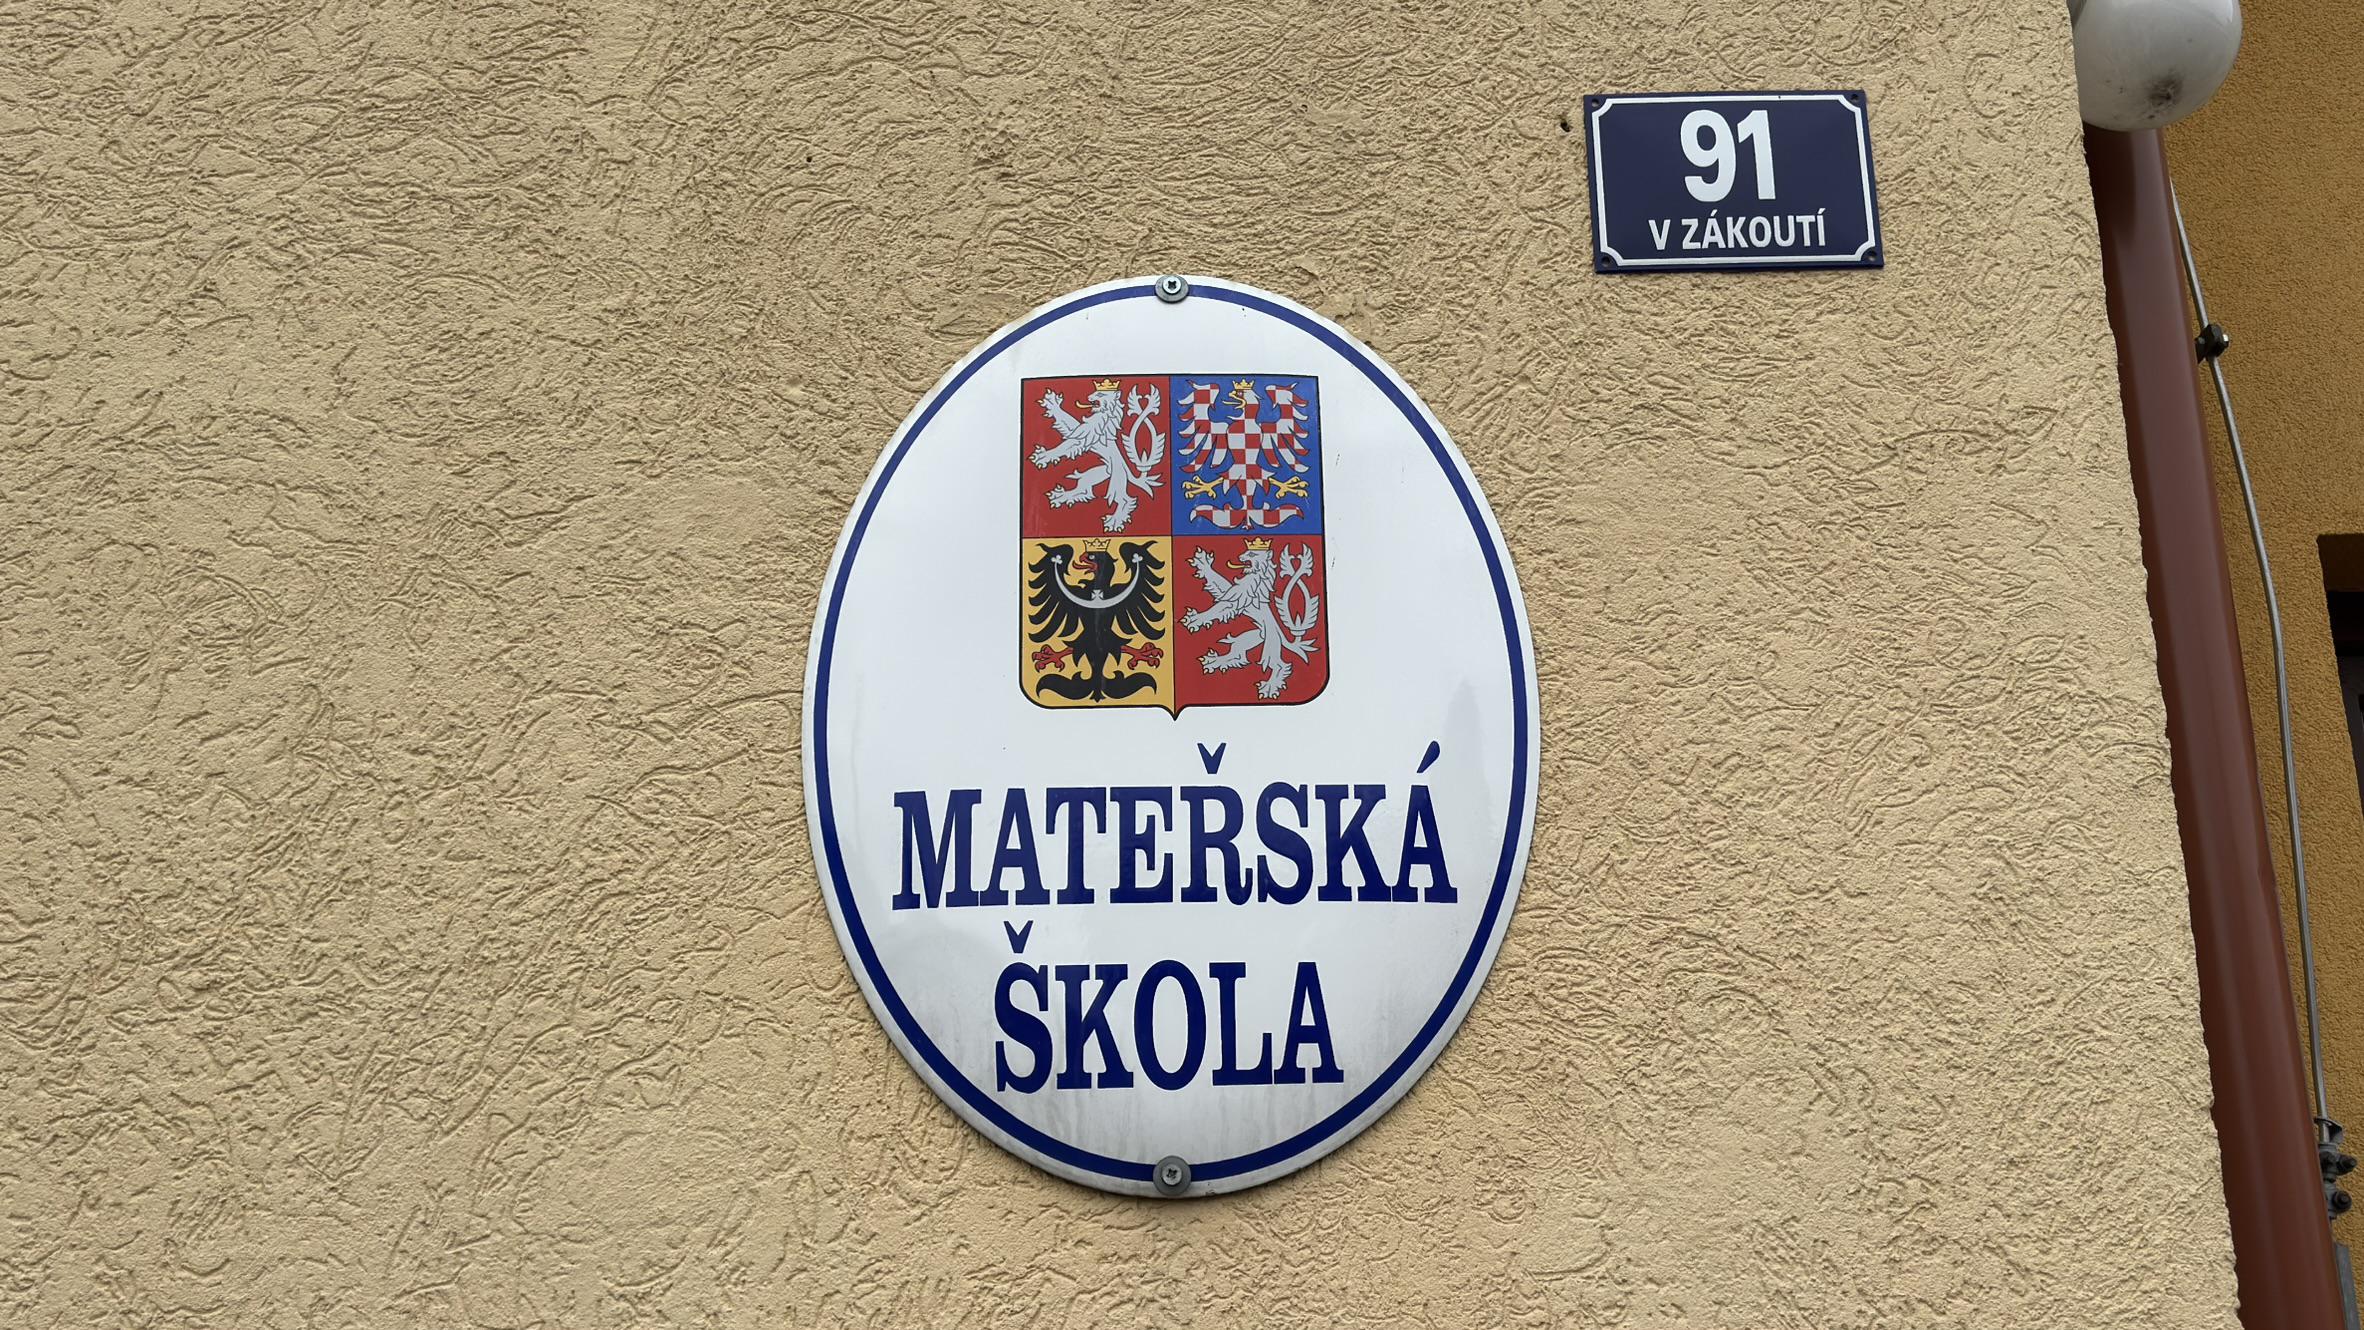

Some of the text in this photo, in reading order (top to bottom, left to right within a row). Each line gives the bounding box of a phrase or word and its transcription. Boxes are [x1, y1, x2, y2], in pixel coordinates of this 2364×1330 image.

[1680, 109, 1776, 202] 91
[1648, 207, 1827, 250] V ZÁKOUTÍ
[892, 740, 1458, 911] MATEŘSKÁ
[994, 920, 1345, 1095] ŠKOLA
